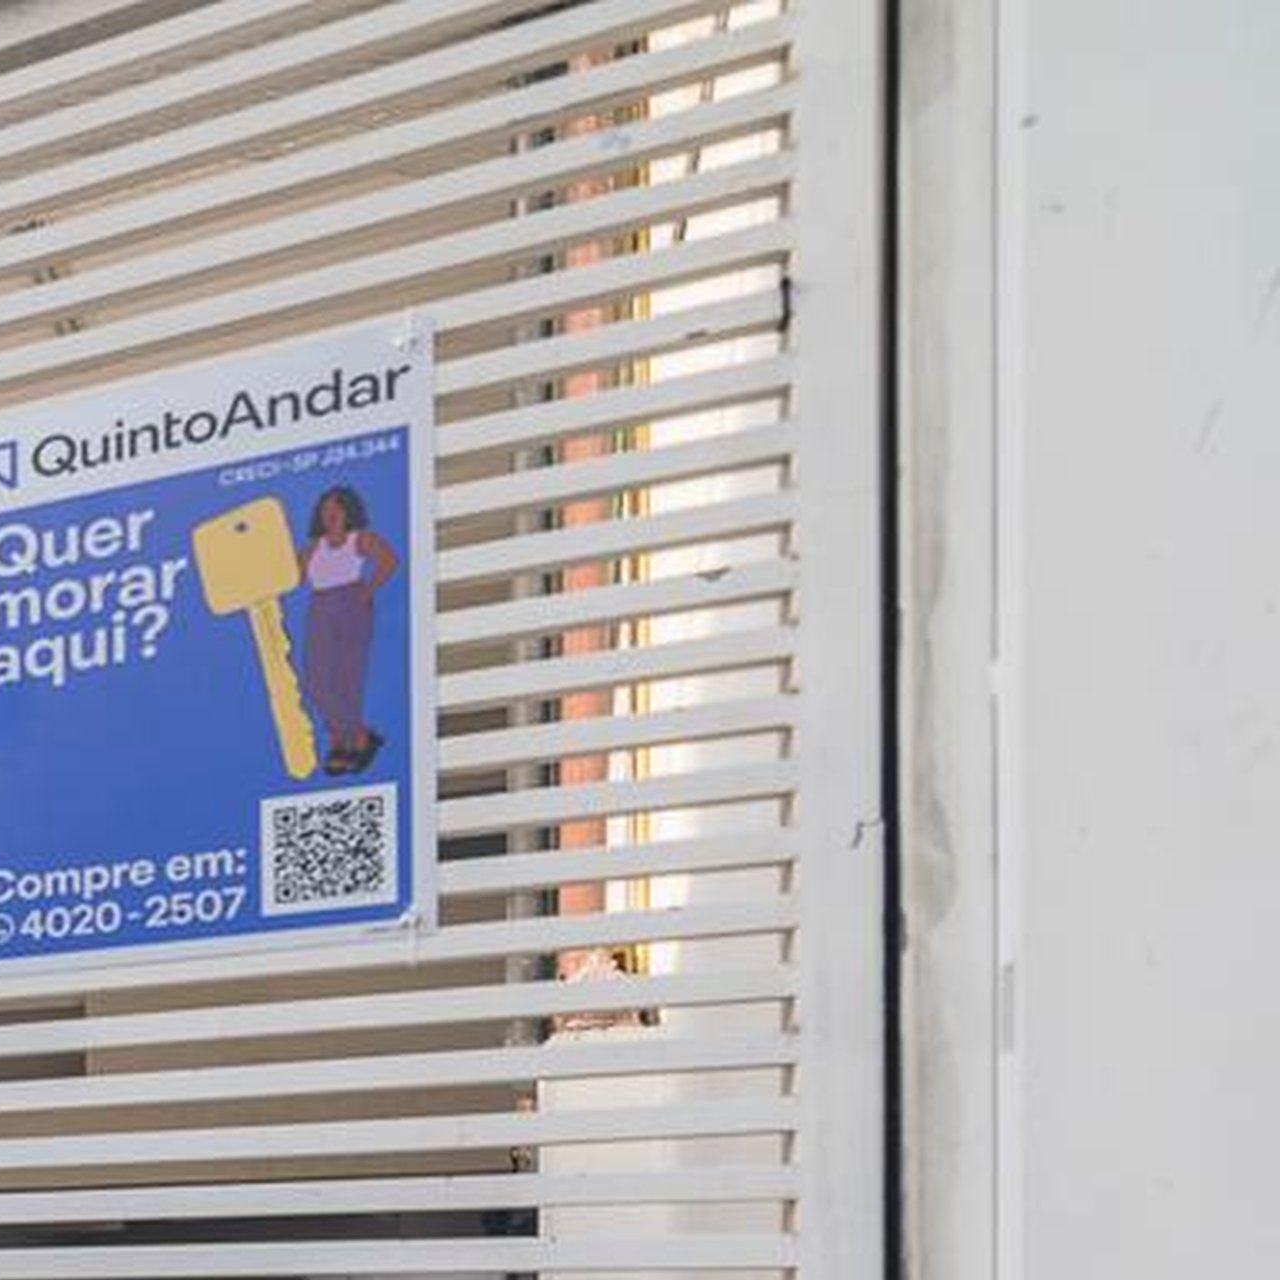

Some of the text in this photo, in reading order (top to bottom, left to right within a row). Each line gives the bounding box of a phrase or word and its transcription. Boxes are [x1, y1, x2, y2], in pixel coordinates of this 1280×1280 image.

[32, 364, 411, 478] QuintoAndar
[166, 848, 248, 882] em:
[20, 886, 246, 939] 4020-2507
